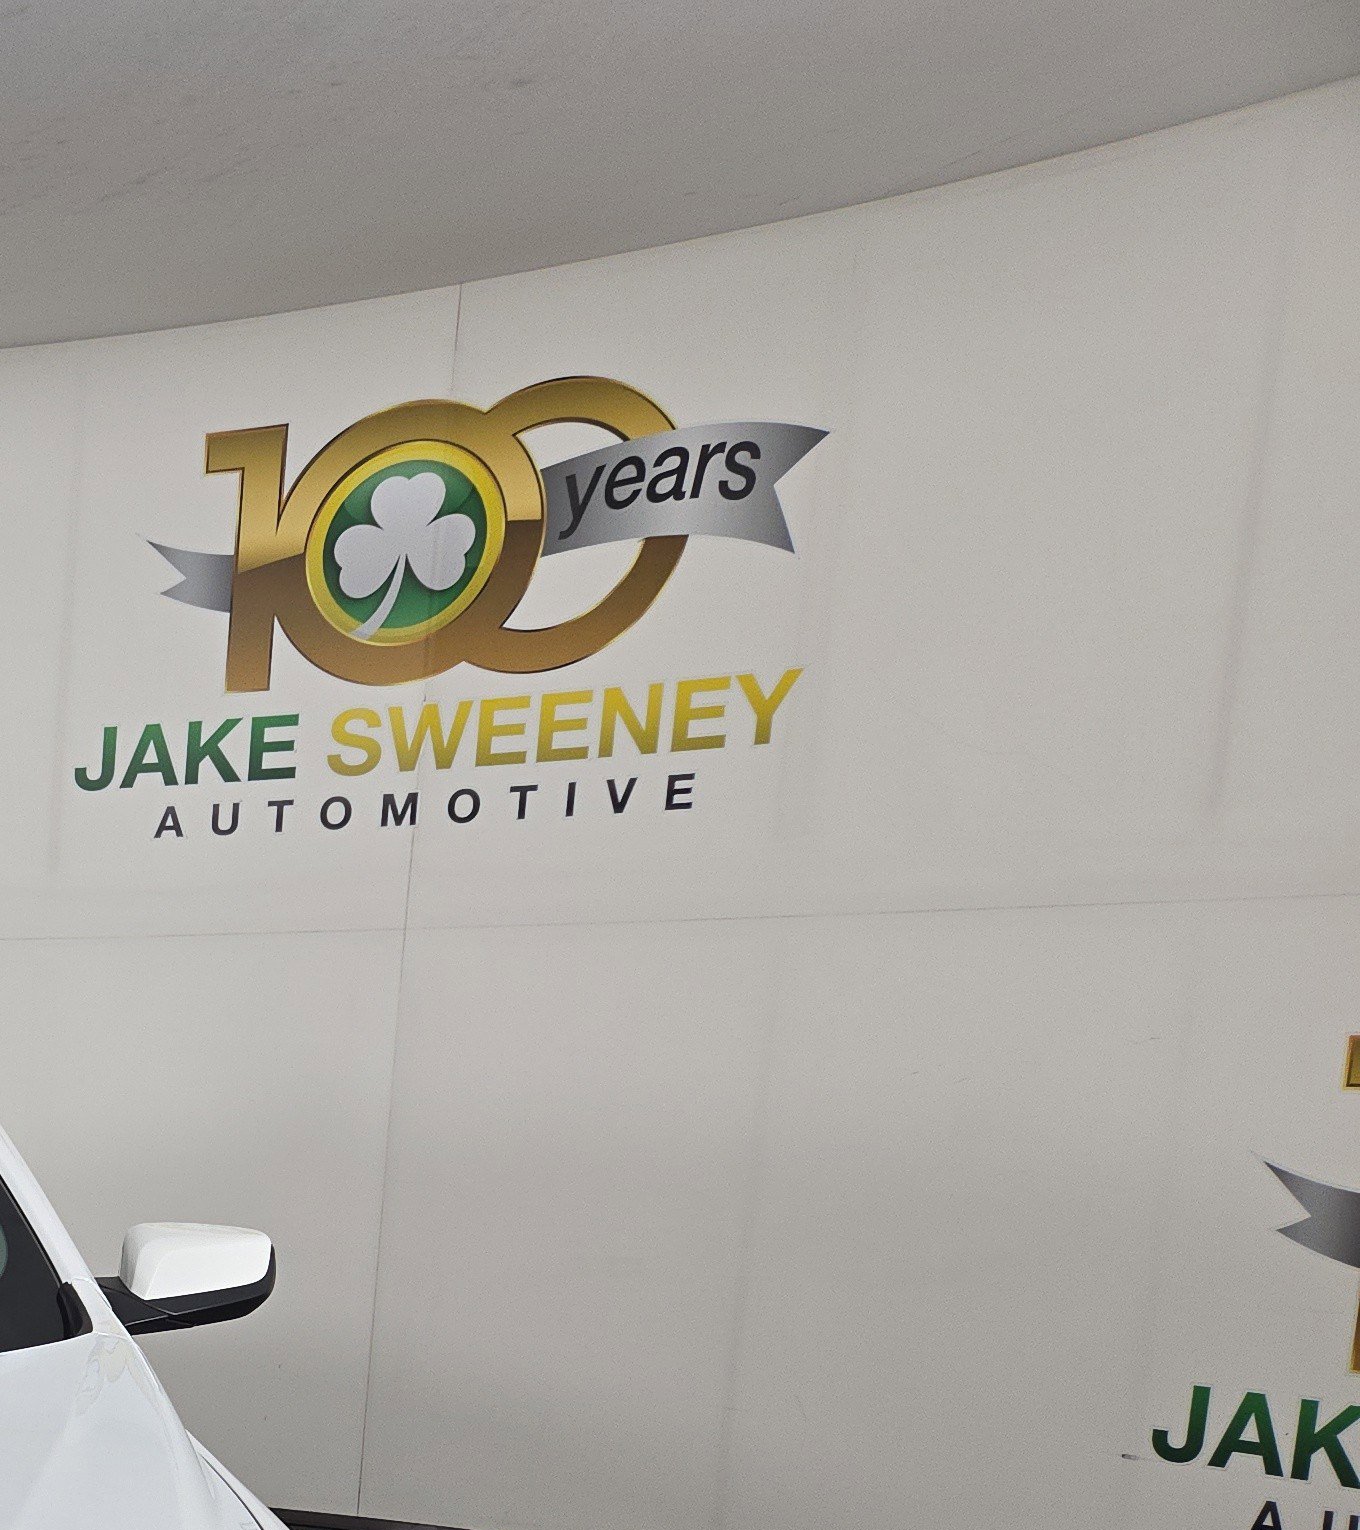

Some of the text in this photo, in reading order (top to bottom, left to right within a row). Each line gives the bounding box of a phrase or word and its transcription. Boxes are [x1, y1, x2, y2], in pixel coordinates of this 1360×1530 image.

[205, 375, 761, 692] 100 years
[74, 667, 804, 792] JAKE SWEENEY
[154, 773, 696, 838] AUTOMOTIVE
[1151, 1385, 1360, 1490] JAK
